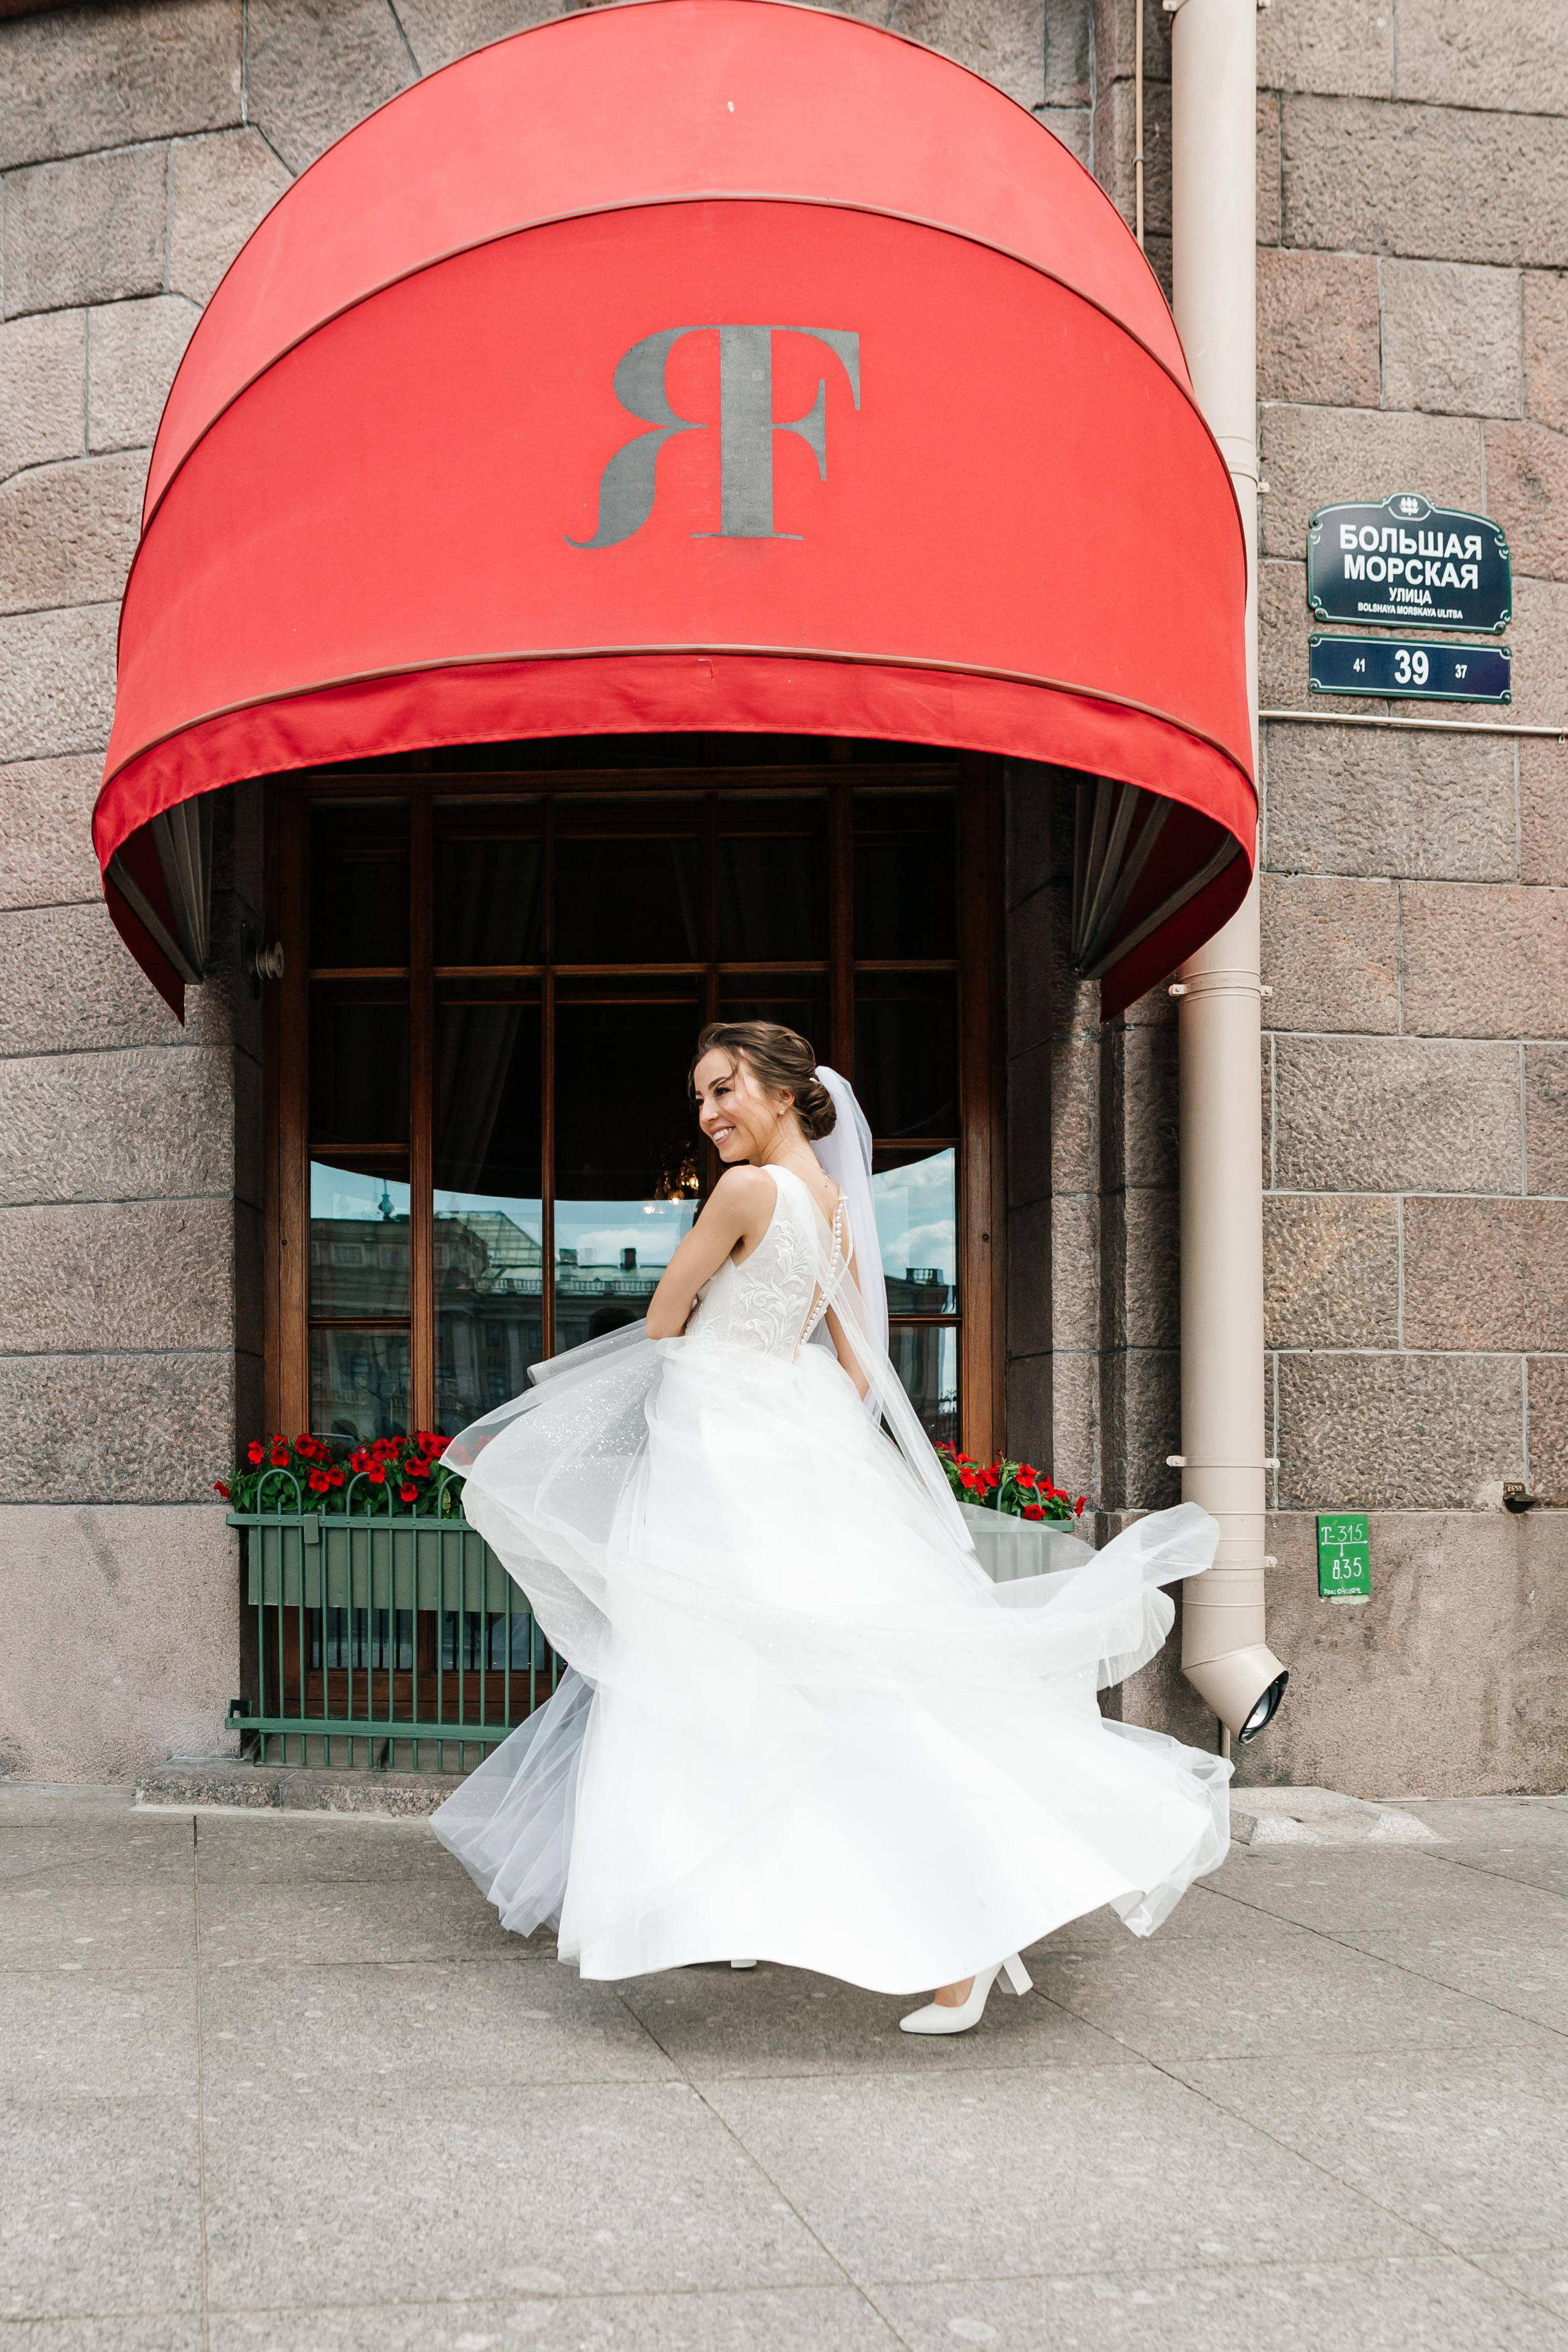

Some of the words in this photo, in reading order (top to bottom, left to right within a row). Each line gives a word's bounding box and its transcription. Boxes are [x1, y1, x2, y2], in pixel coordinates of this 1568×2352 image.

[1339, 523, 1482, 561] БОЛЬШАЯ
[1343, 553, 1479, 590] МОРСКАЯ
[1357, 602, 1396, 614] BOLSHAYA
[1396, 605, 1436, 617] MORSKAYA
[1437, 609, 1463, 619] ULITSA
[1389, 586, 1433, 606] УЛИЦА
[1353, 658, 1365, 673] 41
[1393, 649, 1429, 685] 39
[1455, 664, 1468, 679] 37
